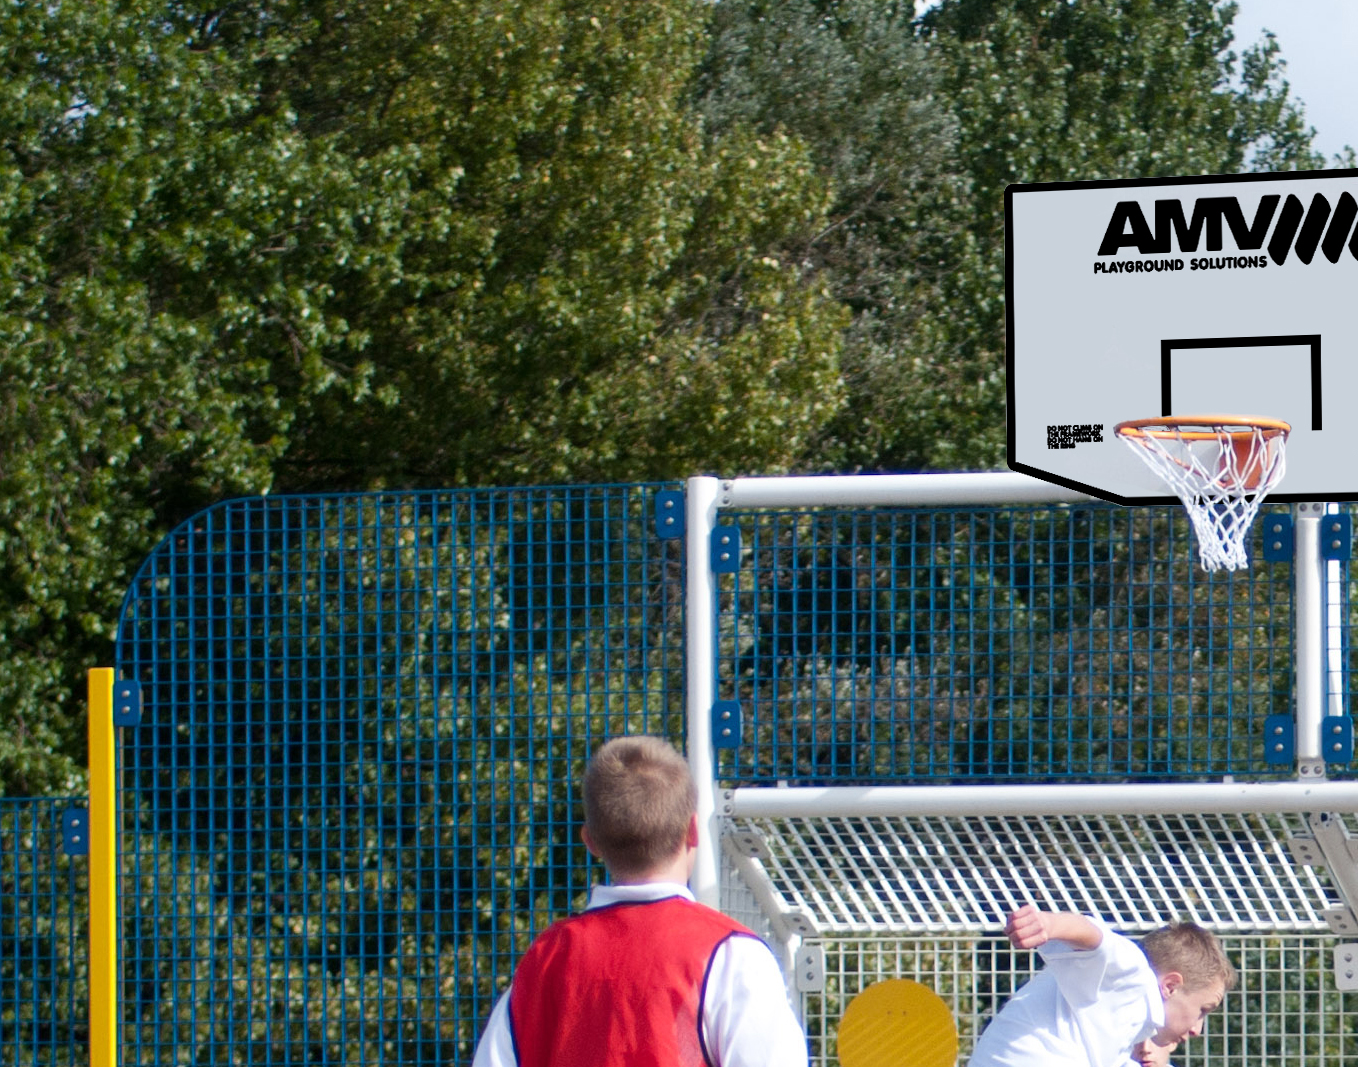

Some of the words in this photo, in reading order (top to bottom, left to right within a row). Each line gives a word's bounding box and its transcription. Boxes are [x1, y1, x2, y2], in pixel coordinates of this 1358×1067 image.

[1097, 194, 1281, 256] AMV
[1094, 259, 1184, 274] PLAYGROUND
[1190, 256, 1267, 271] SOLUTIONS
